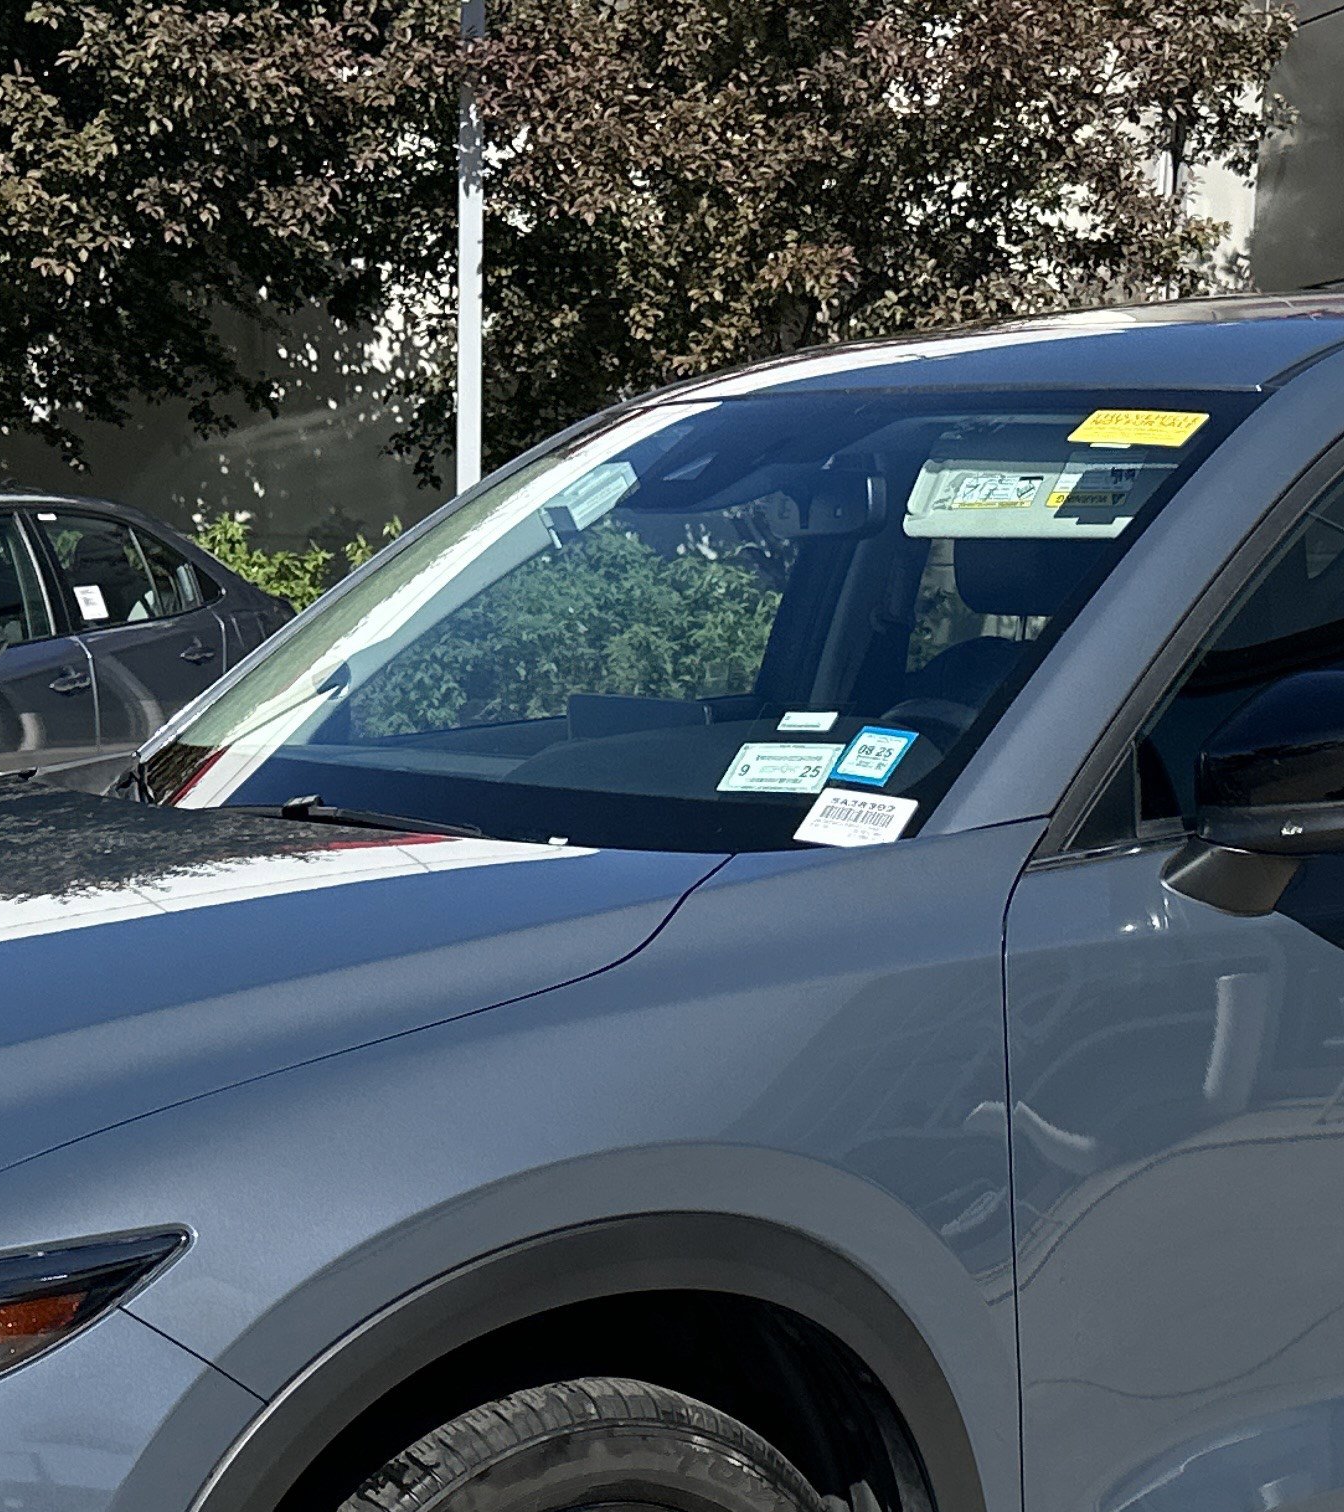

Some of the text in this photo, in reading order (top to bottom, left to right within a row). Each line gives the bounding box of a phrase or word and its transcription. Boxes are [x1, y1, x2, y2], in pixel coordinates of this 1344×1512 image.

[875, 747, 894, 758] 25
[738, 764, 823, 778] 9 25
